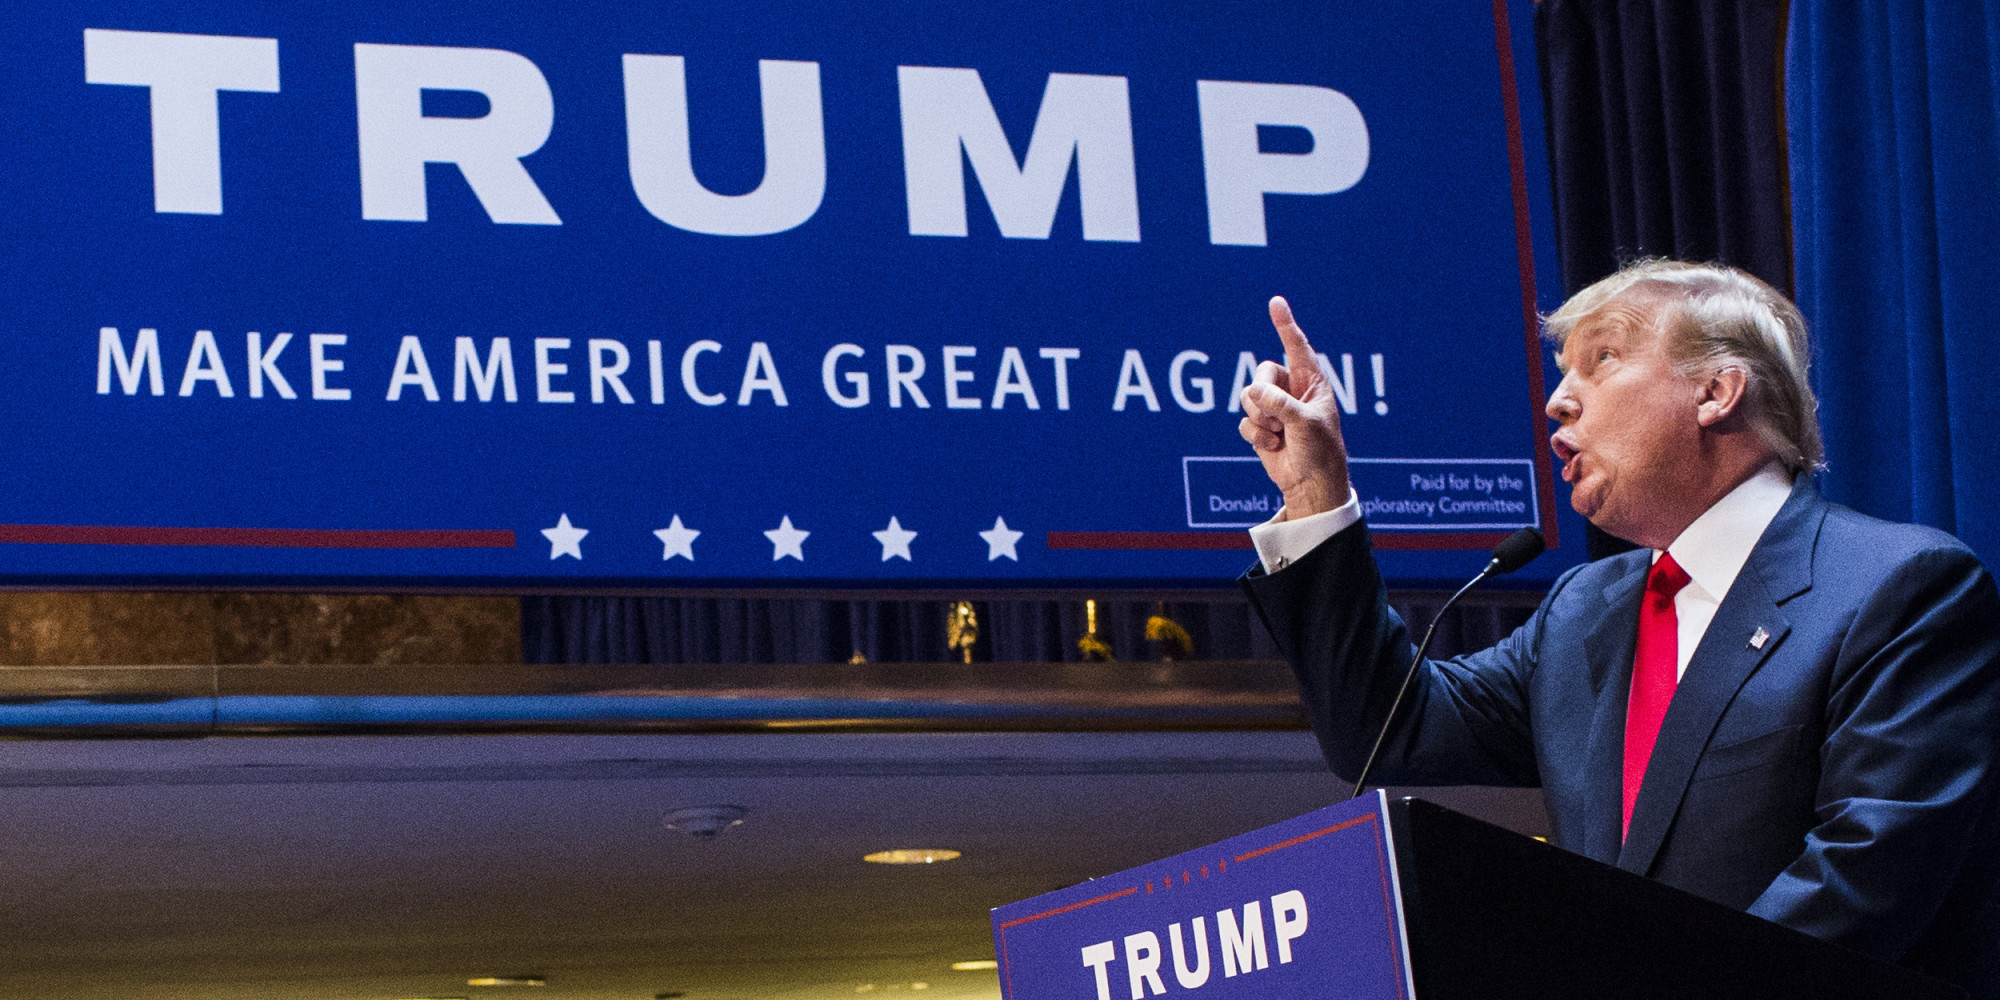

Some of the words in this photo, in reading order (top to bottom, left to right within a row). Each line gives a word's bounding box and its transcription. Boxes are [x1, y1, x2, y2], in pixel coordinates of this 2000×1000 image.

[84, 28, 1370, 246] TRUMP
[96, 326, 351, 401] MAKE
[386, 335, 788, 407] AMERICA
[822, 343, 1081, 411] GREAT
[1113, 349, 1390, 416] AGAN!
[1209, 494, 1269, 513] Donald
[1438, 496, 1526, 514] Committee
[1410, 473, 1445, 491] Paid
[1448, 473, 1471, 491] for
[1474, 473, 1494, 494] by
[1497, 474, 1523, 491] the
[1081, 889, 1309, 1000] TRUMP
